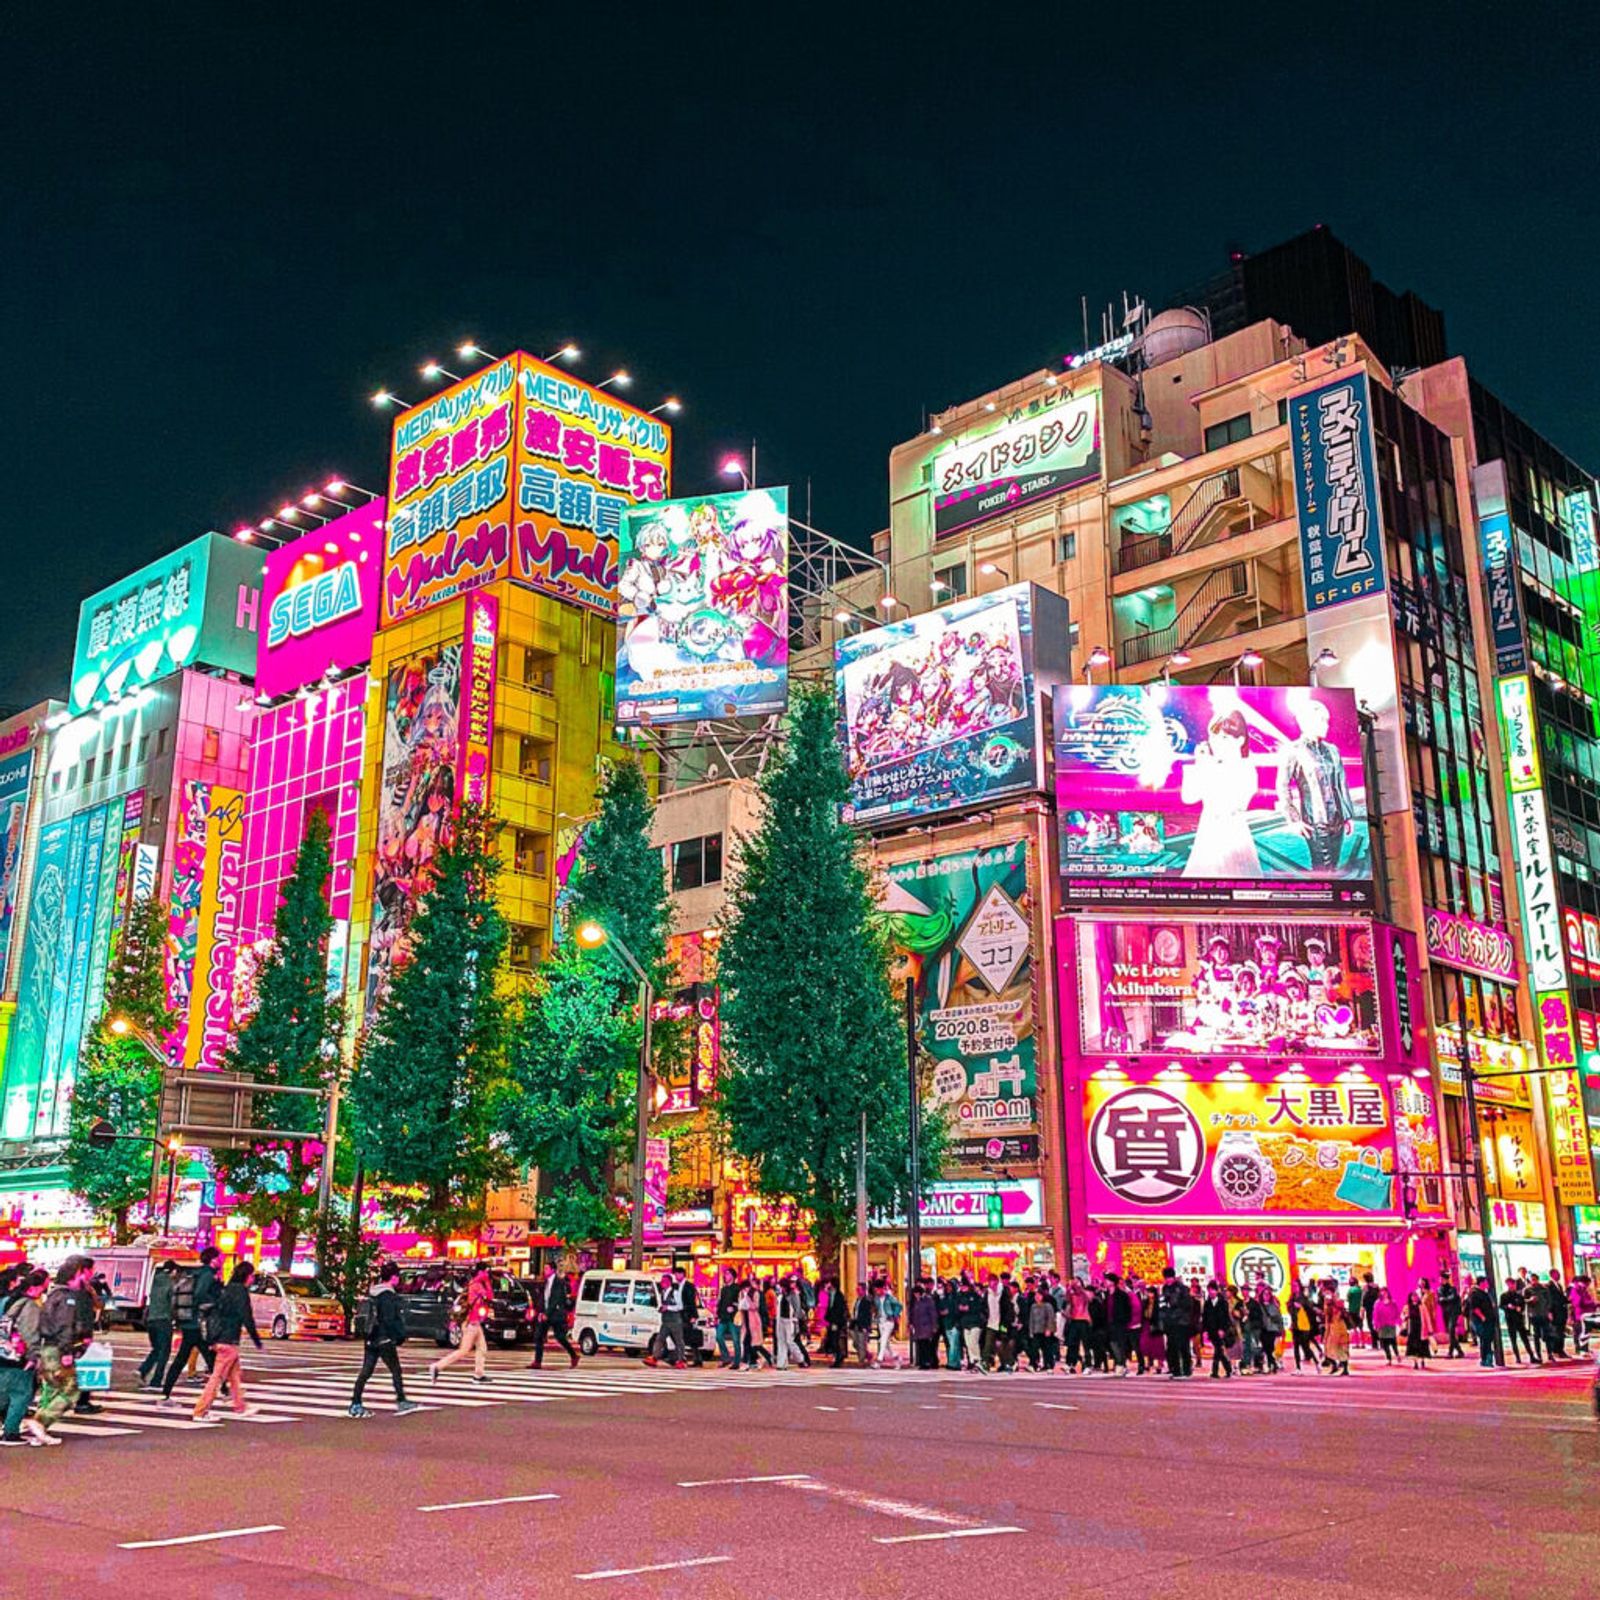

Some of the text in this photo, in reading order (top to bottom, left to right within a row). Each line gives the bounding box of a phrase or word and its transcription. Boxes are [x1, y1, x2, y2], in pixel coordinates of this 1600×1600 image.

[394, 403, 513, 501] 激安販売
[523, 406, 666, 500] 激安販売
[942, 411, 1088, 492] メイドカジノ
[389, 457, 508, 557] 高額買取
[978, 491, 1006, 511] POKER
[387, 522, 509, 617] Mulan
[236, 584, 259, 632] H
[268, 561, 362, 648] SEGA
[431, 585, 457, 603] AKIBA
[532, 572, 611, 609] ムーラン AKIBA
[981, 945, 1013, 967] ココ
[1427, 915, 1513, 973] メイドカジノ
[1104, 981, 1193, 995] Akihabara
[1113, 963, 1181, 977] We Love
[938, 1018, 990, 1038] 2020.8
[961, 1036, 1015, 1052] 予約受付中
[1266, 1088, 1386, 1128] 大黒屋
[1567, 1068, 1580, 1108] TAX
[960, 1099, 1030, 1118] amiami
[1211, 1113, 1259, 1127] チケット
[1104, 1106, 1195, 1189] 質
[1570, 1114, 1588, 1166] FREE
[487, 1223, 523, 1239] ラーメン
